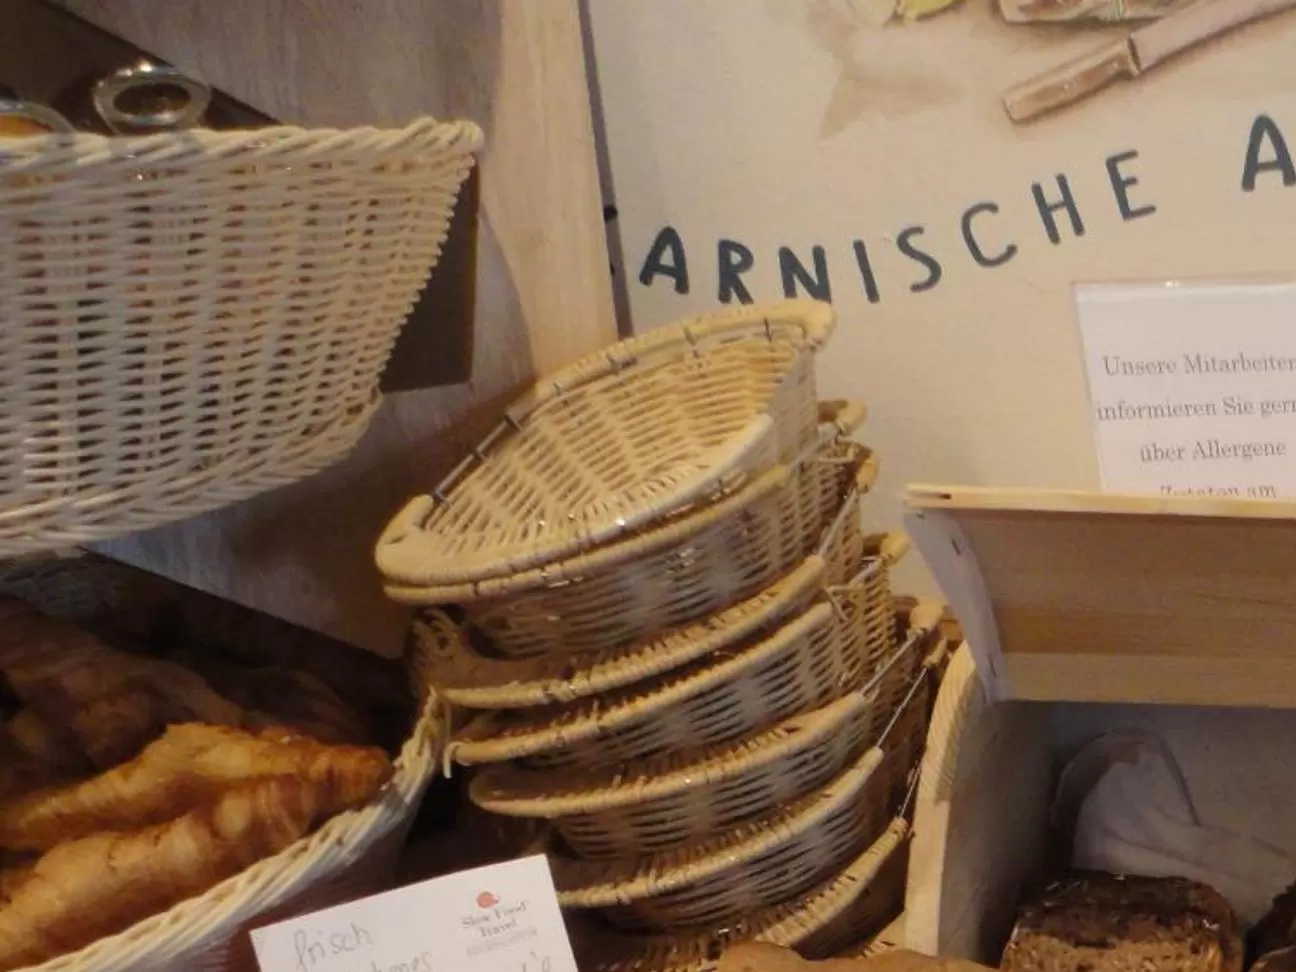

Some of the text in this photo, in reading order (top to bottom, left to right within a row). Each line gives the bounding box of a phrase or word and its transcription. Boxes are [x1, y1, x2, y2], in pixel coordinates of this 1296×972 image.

[639, 150, 1156, 305] ARNISCHE
[1103, 352, 1296, 376] Unsere Mitarbeiter
[1097, 400, 1217, 421] informieren
[1222, 395, 1252, 416] Sie
[1140, 439, 1286, 462] über Allergene
